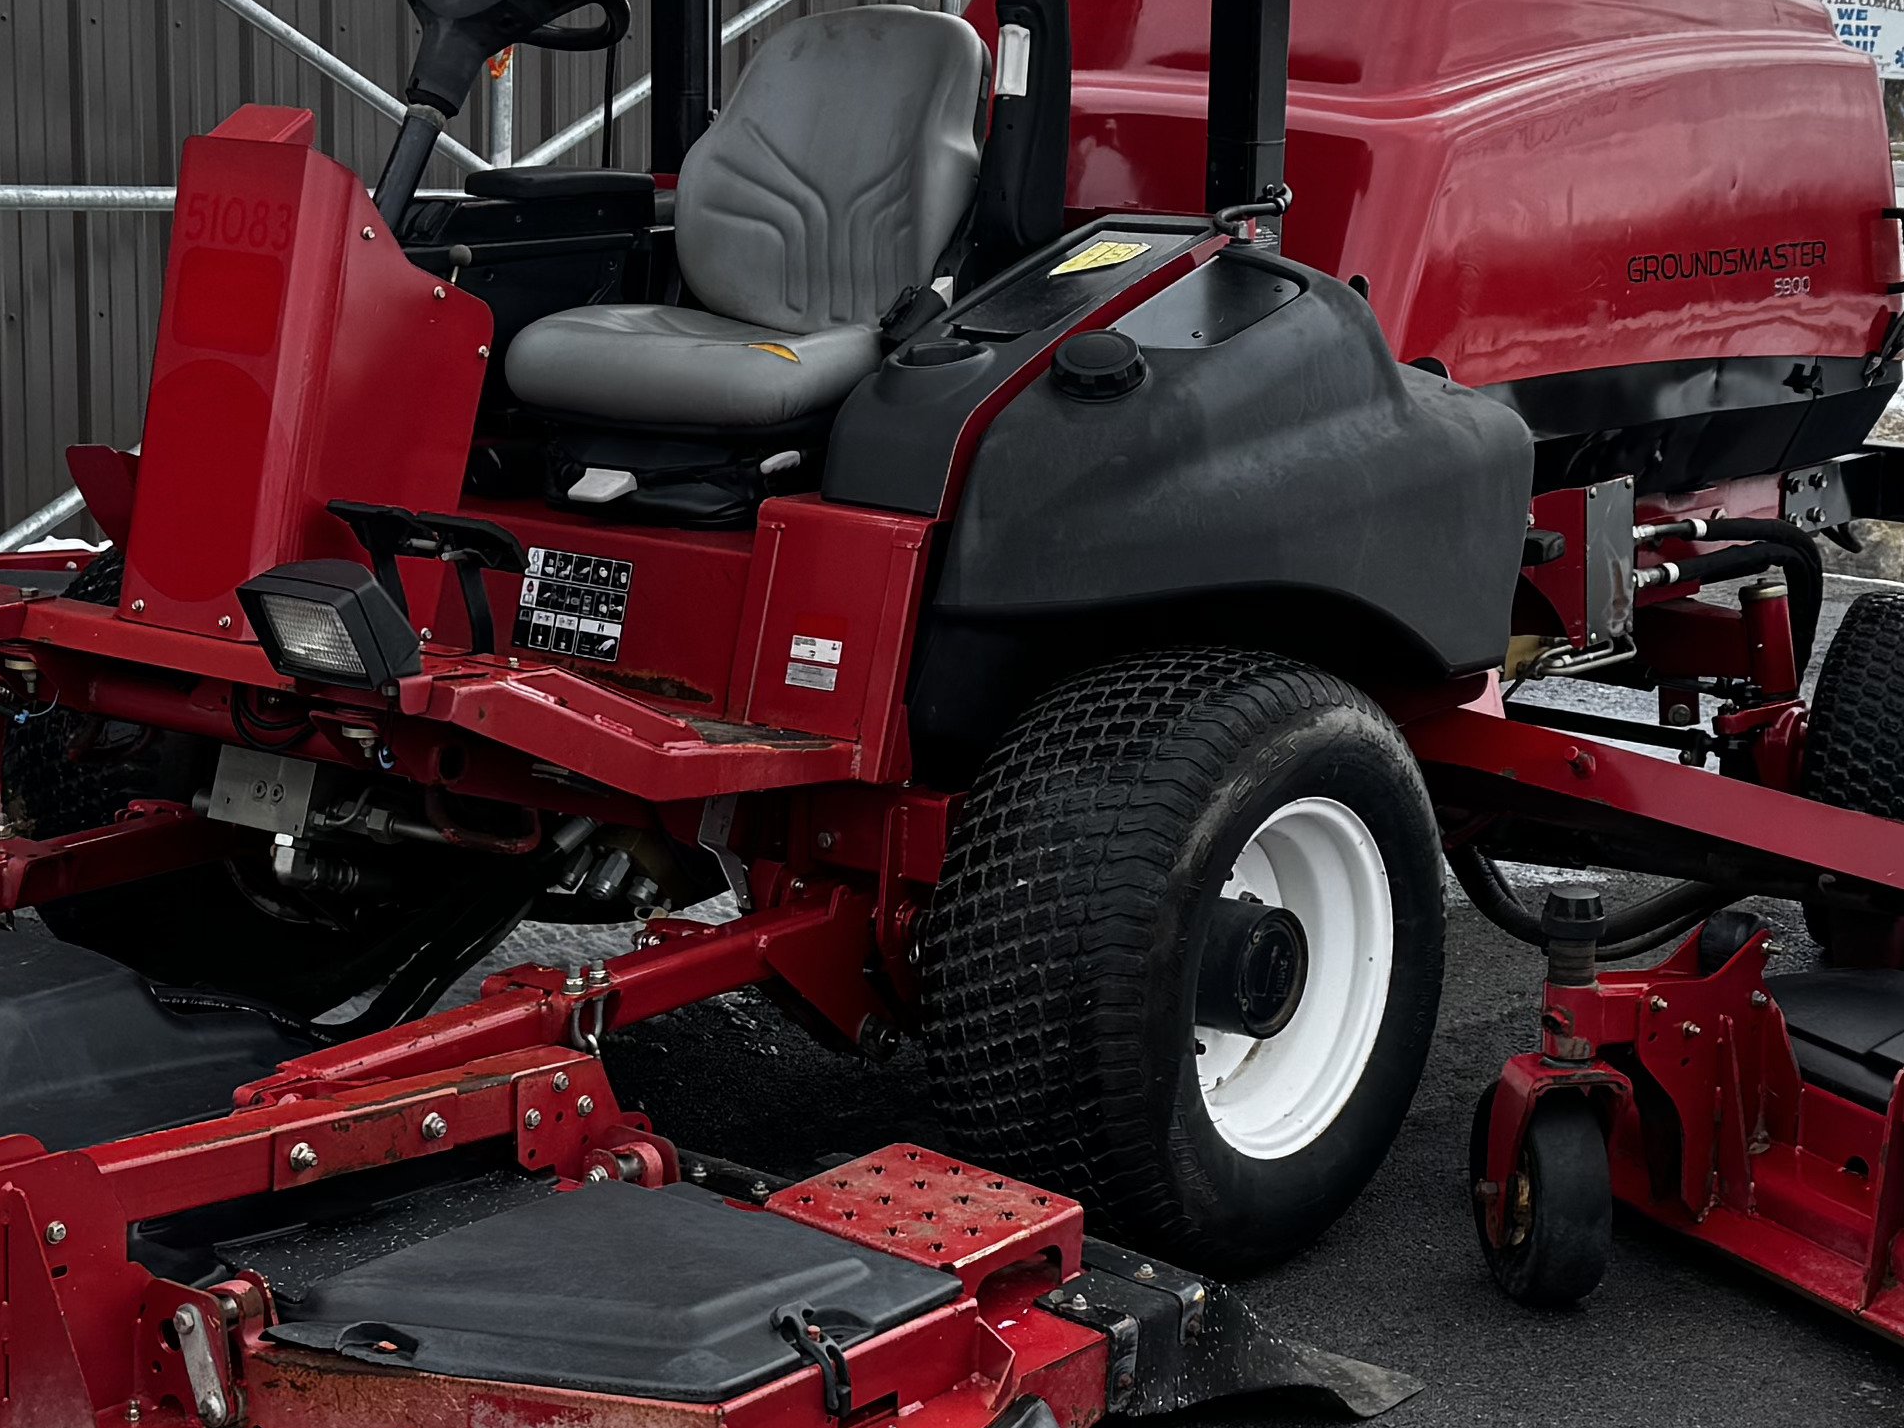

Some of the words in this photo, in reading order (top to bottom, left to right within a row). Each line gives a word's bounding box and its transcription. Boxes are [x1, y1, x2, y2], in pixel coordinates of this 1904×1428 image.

[1837, 7, 1869, 21] WE
[1841, 39, 1875, 53] U!
[183, 192, 293, 252] 51083
[1627, 240, 1827, 284] GROUNDSMASTER
[1774, 275, 1811, 297] 5900
